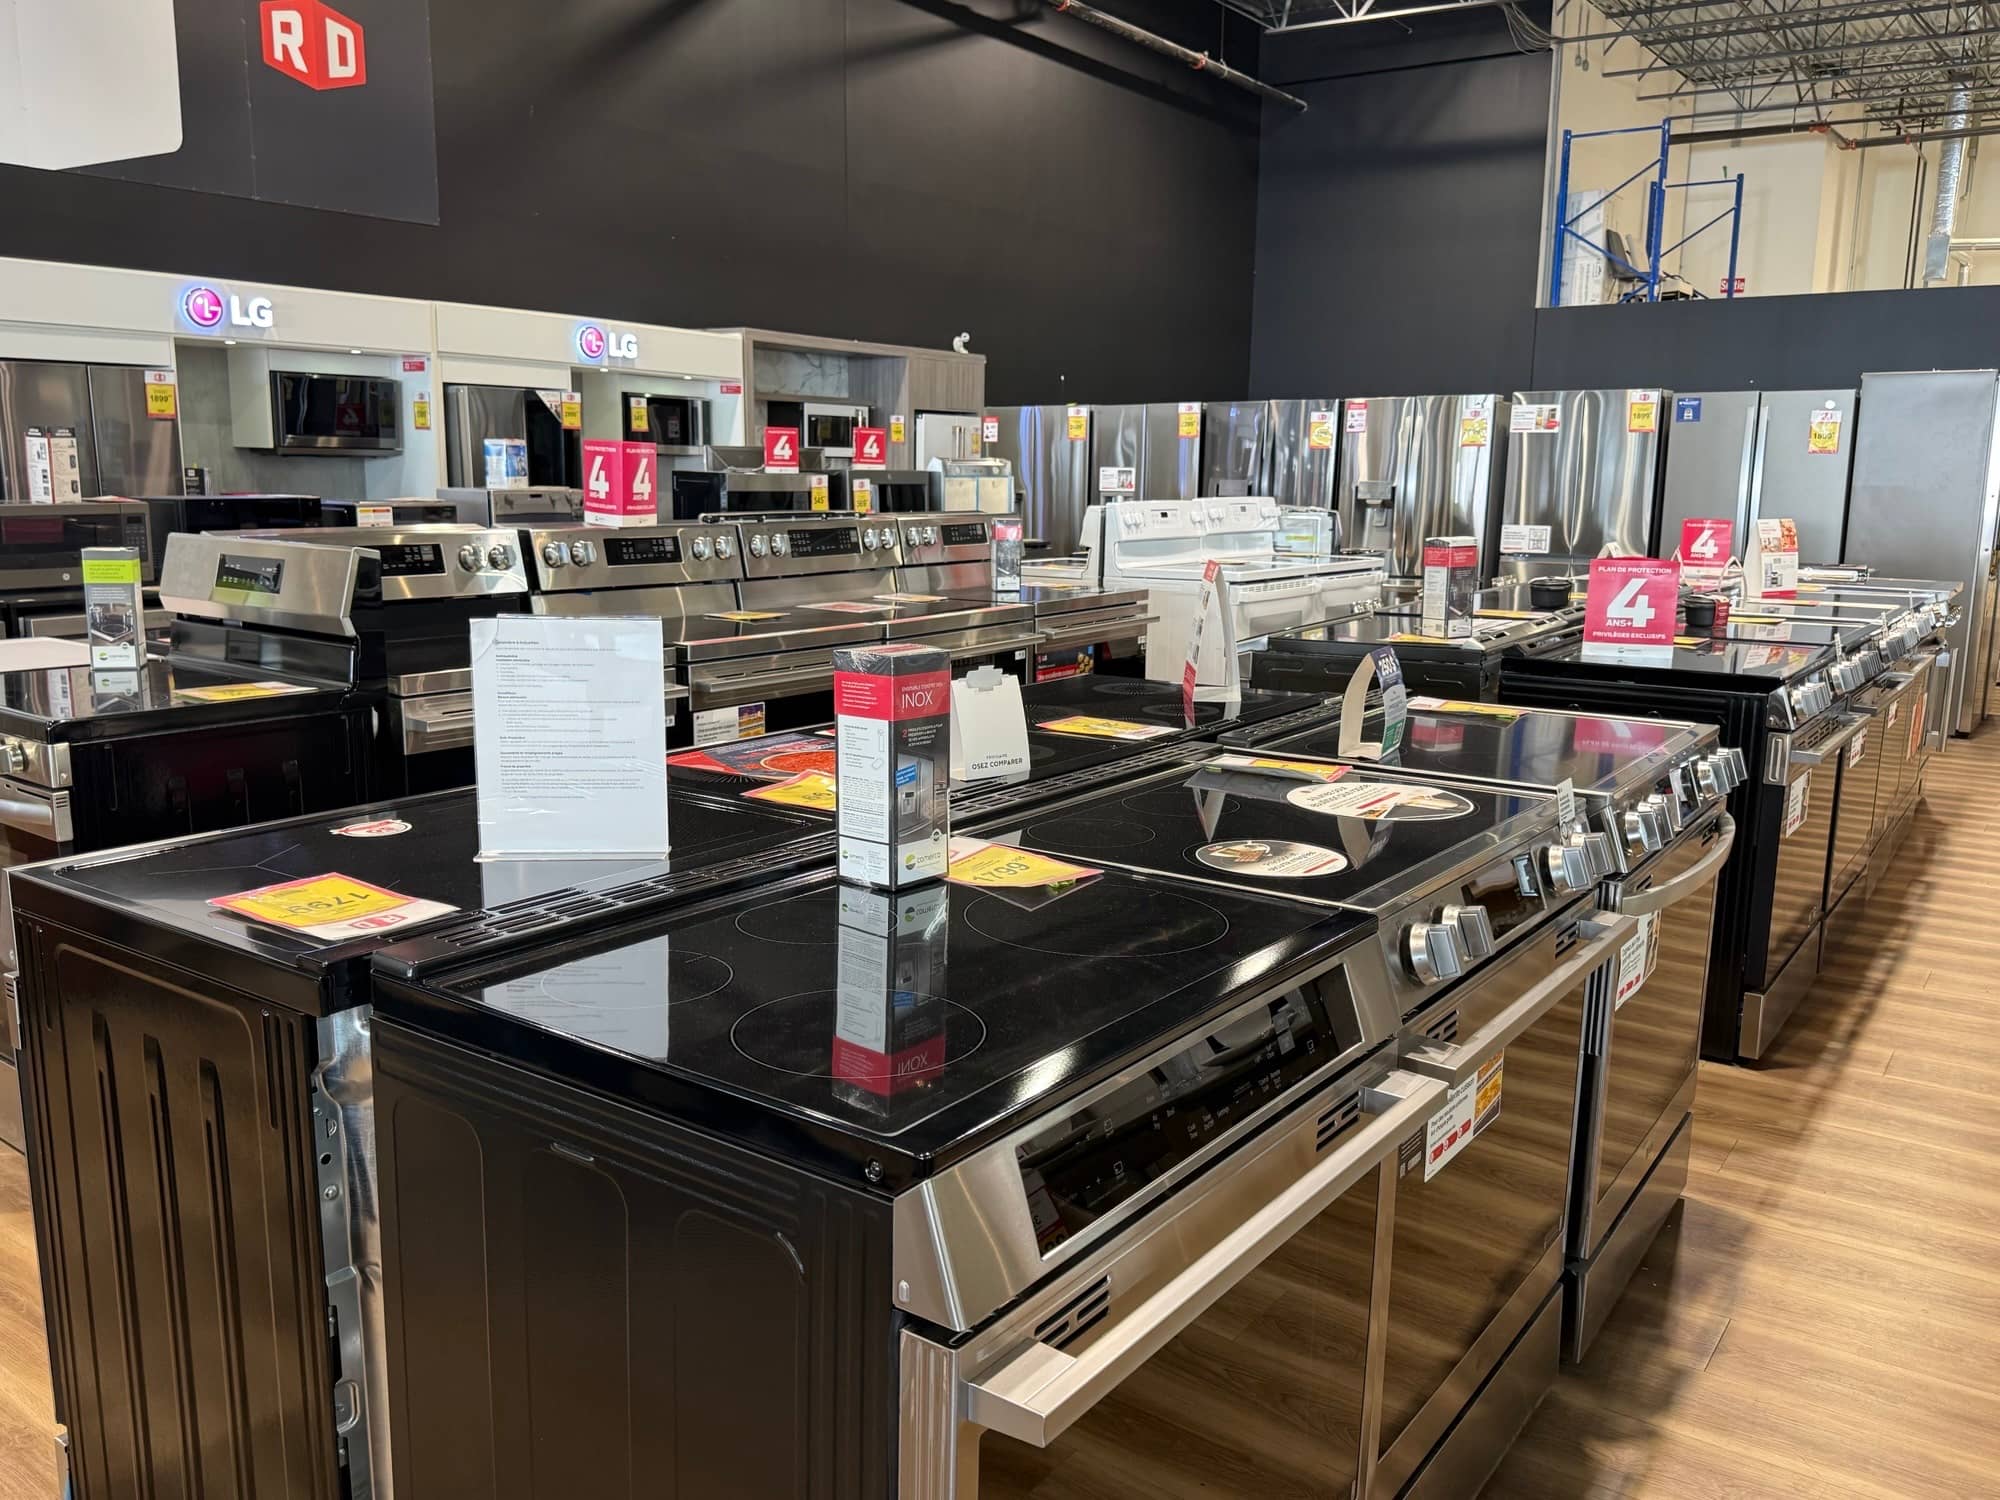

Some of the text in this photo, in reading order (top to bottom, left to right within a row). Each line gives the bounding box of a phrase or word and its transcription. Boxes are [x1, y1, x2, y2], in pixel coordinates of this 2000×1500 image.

[231, 295, 273, 327] LG
[608, 332, 638, 359] LG
[773, 435, 793, 459] 4
[863, 435, 880, 458] 4
[589, 455, 610, 499] 4
[632, 458, 652, 500] 4
[1690, 530, 1719, 558] 4
[1606, 577, 1656, 628] 4
[901, 690, 933, 709] INOX
[971, 757, 1023, 770] OSEZ COMPARER
[972, 862, 1031, 882] 1799
[286, 891, 371, 915] 1799
